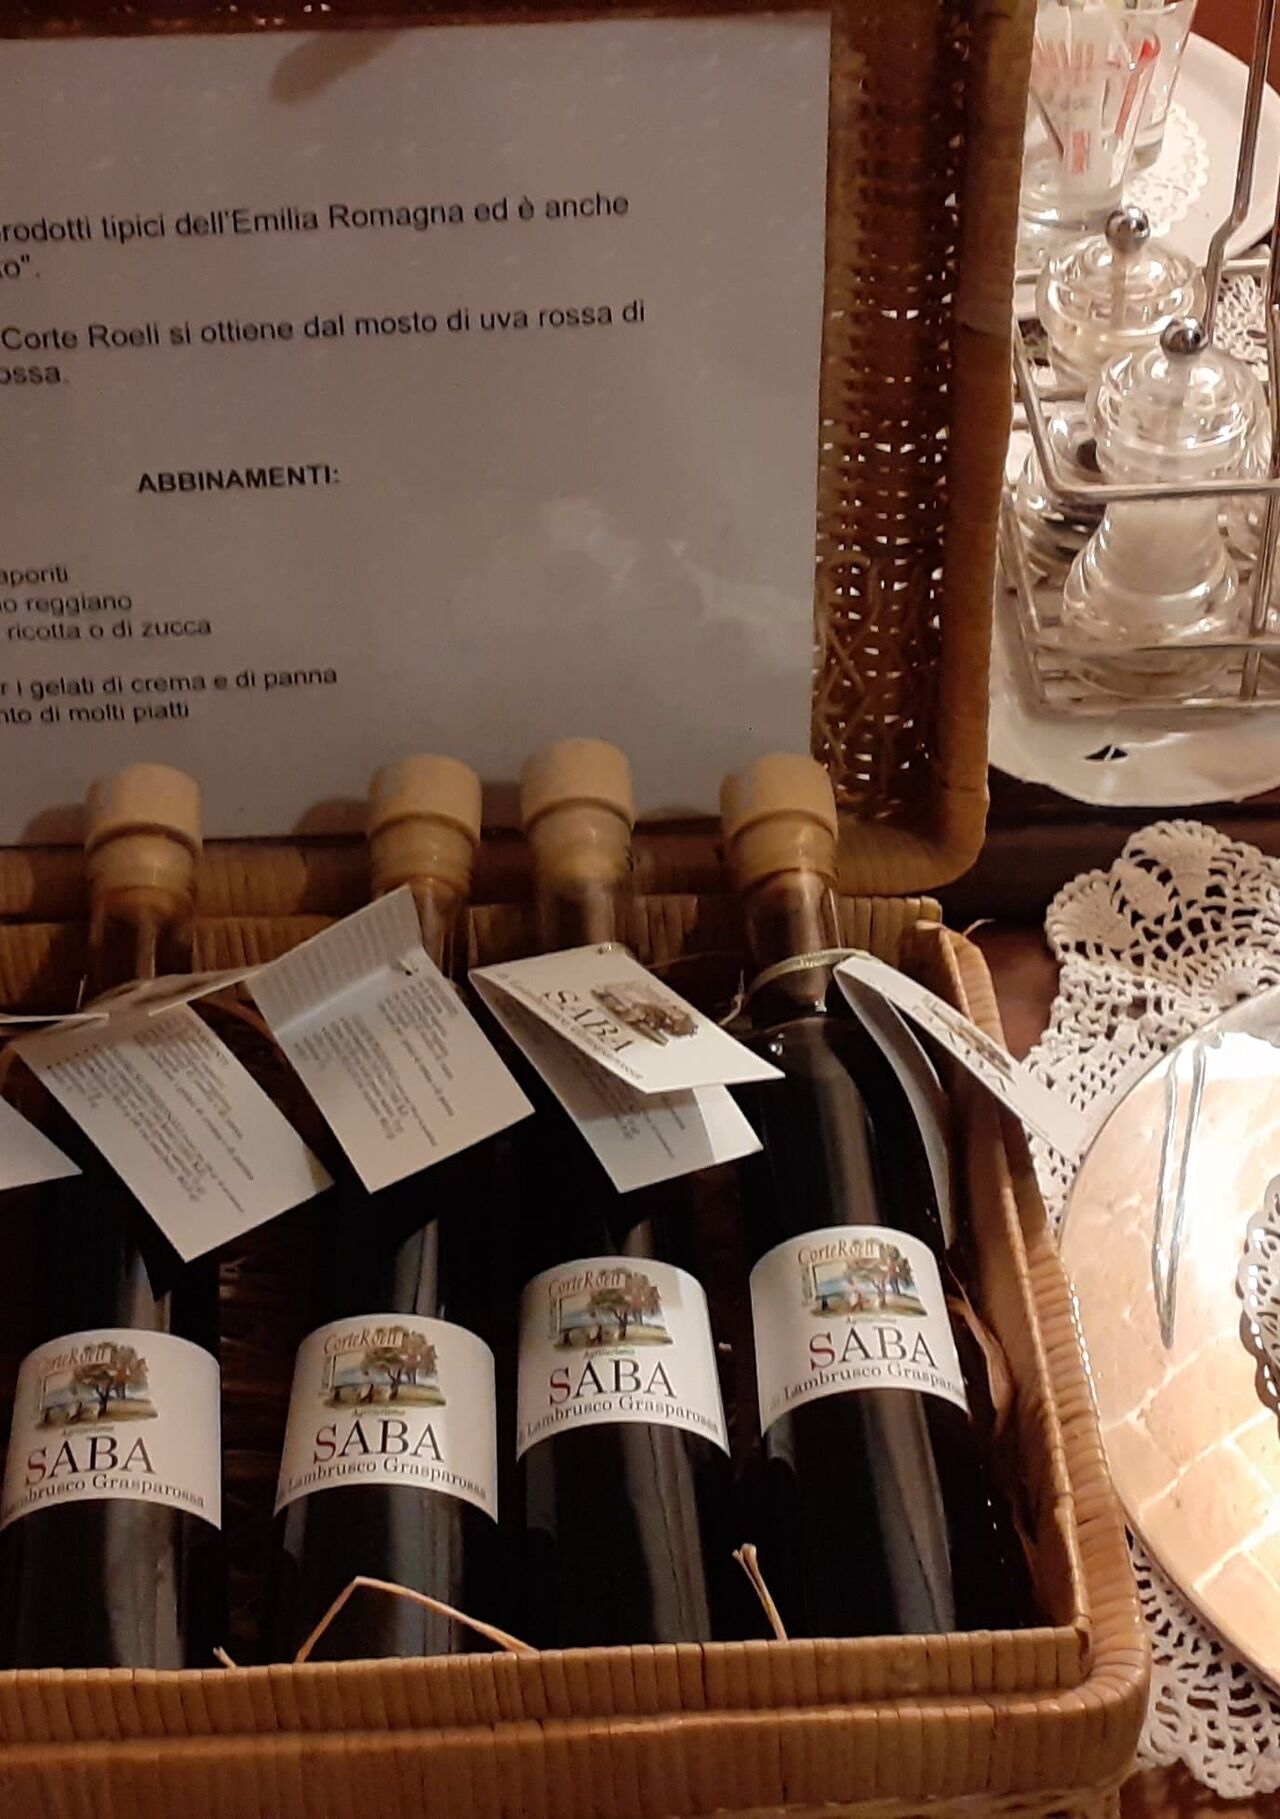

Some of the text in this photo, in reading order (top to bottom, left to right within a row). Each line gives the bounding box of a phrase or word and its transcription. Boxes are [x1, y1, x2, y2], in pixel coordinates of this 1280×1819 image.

[101, 213, 165, 245] tipici
[175, 208, 318, 237] dell'Emilia
[329, 203, 464, 232] Romagna
[474, 197, 508, 223] ed
[518, 195, 534, 222] è
[545, 192, 628, 220] anche
[1, 326, 78, 351] Corte
[88, 322, 159, 349] Roeli
[169, 321, 192, 346] si
[200, 319, 294, 345] ottiene
[304, 313, 344, 339] dal
[355, 311, 437, 336] mosto
[447, 308, 470, 334] di
[480, 310, 528, 332] uva
[539, 306, 612, 328] rossa
[622, 299, 644, 324] di
[136, 464, 340, 494] ABBINAMENTI:
[26, 593, 132, 616] reggiano
[8, 623, 81, 641] ricotta
[89, 625, 104, 640] o
[112, 619, 132, 639] di
[142, 619, 212, 638] zucca
[17, 680, 22, 696] i
[30, 677, 94, 701] gelati
[102, 675, 123, 695] di
[131, 675, 206, 693] crema
[213, 675, 227, 690] e
[236, 670, 256, 689] di
[264, 668, 337, 692] panna
[40, 705, 60, 725] di
[69, 703, 125, 722] molti
[133, 702, 189, 724] piatti
[809, 1326, 939, 1371] SABA
[548, 1358, 677, 1406] SABA
[784, 1364, 882, 1401] Lambrusco
[526, 1395, 719, 1437] Lambrusco Grasparossa
[24, 1435, 155, 1486] SABA
[313, 1418, 445, 1465] SABA
[92, 1473, 205, 1510] Grasparossa
[288, 1456, 487, 1500] Lambrusco Grasparossa
